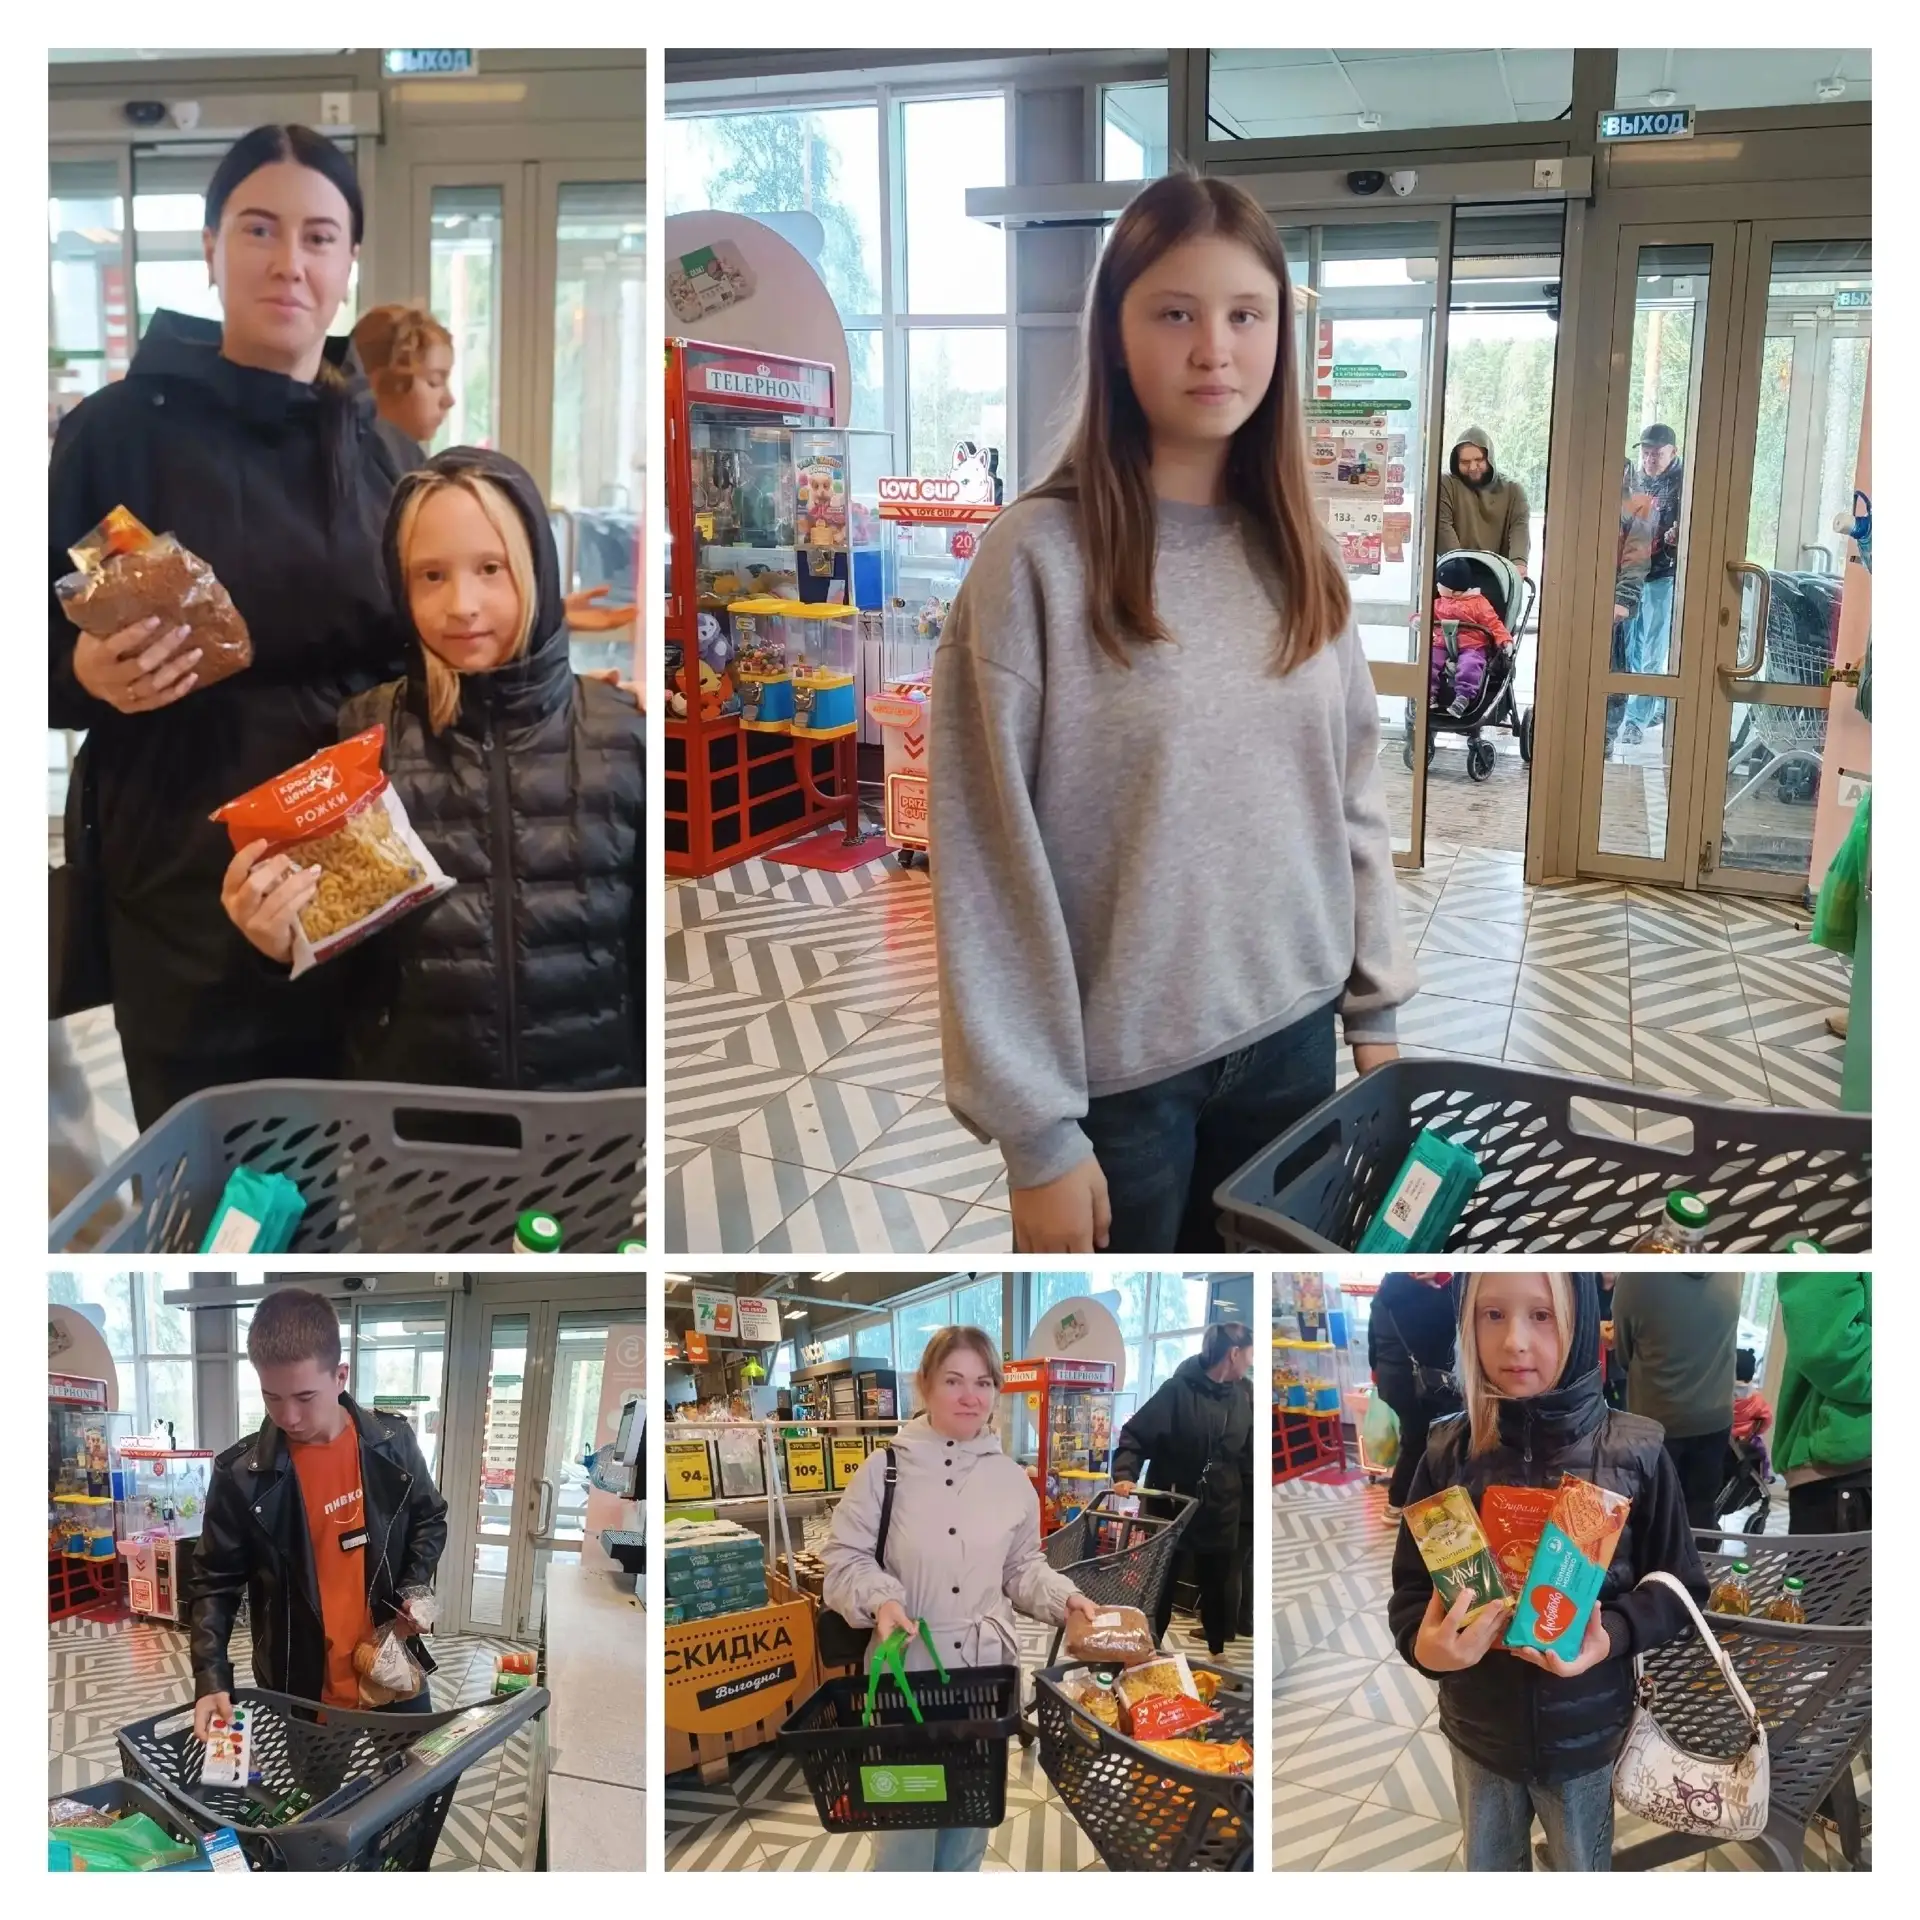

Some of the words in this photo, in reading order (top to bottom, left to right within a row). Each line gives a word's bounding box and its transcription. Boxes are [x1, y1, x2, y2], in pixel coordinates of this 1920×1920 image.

[1606, 113, 1687, 135] ВЫХОД
[711, 372, 812, 400] TELEPHONE
[879, 479, 919, 500] LOVE
[1364, 514, 1378, 522] 49
[956, 535, 972, 548] 20
[295, 792, 348, 828] РОЖКИ
[681, 1470, 702, 1482] 94
[794, 1464, 817, 1476] 109
[844, 1463, 859, 1473] 89
[324, 1488, 363, 1515] ПИВКО
[1539, 1591, 1564, 1637] Любятово
[665, 1626, 793, 1674] СКИДКА
[715, 1667, 781, 1699] Выгодно!
